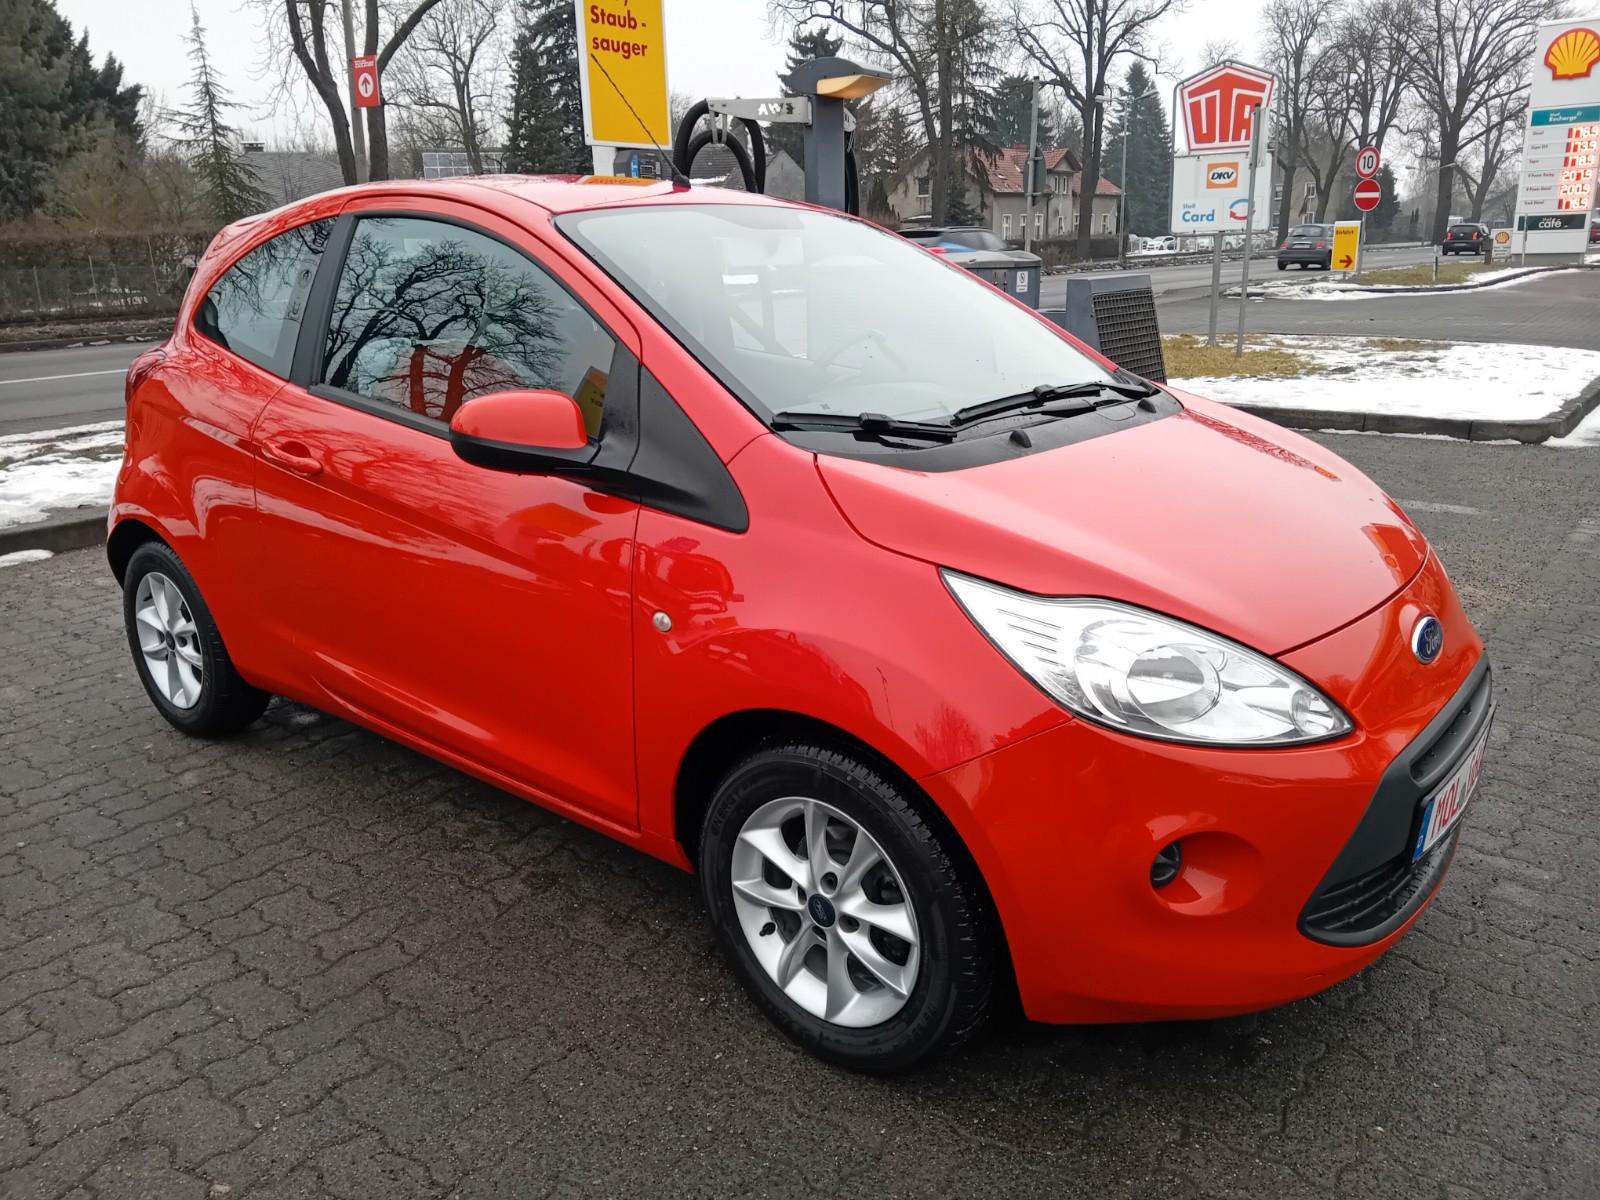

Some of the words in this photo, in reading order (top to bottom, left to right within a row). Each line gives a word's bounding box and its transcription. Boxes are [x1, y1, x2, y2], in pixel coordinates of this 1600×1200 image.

[592, 37, 647, 59] sauger
[1188, 72, 1266, 144] UTA
[1362, 155, 1374, 170] 10
[1211, 171, 1234, 180] DKV
[1182, 209, 1215, 223] Card
[1538, 217, 1562, 229] café
